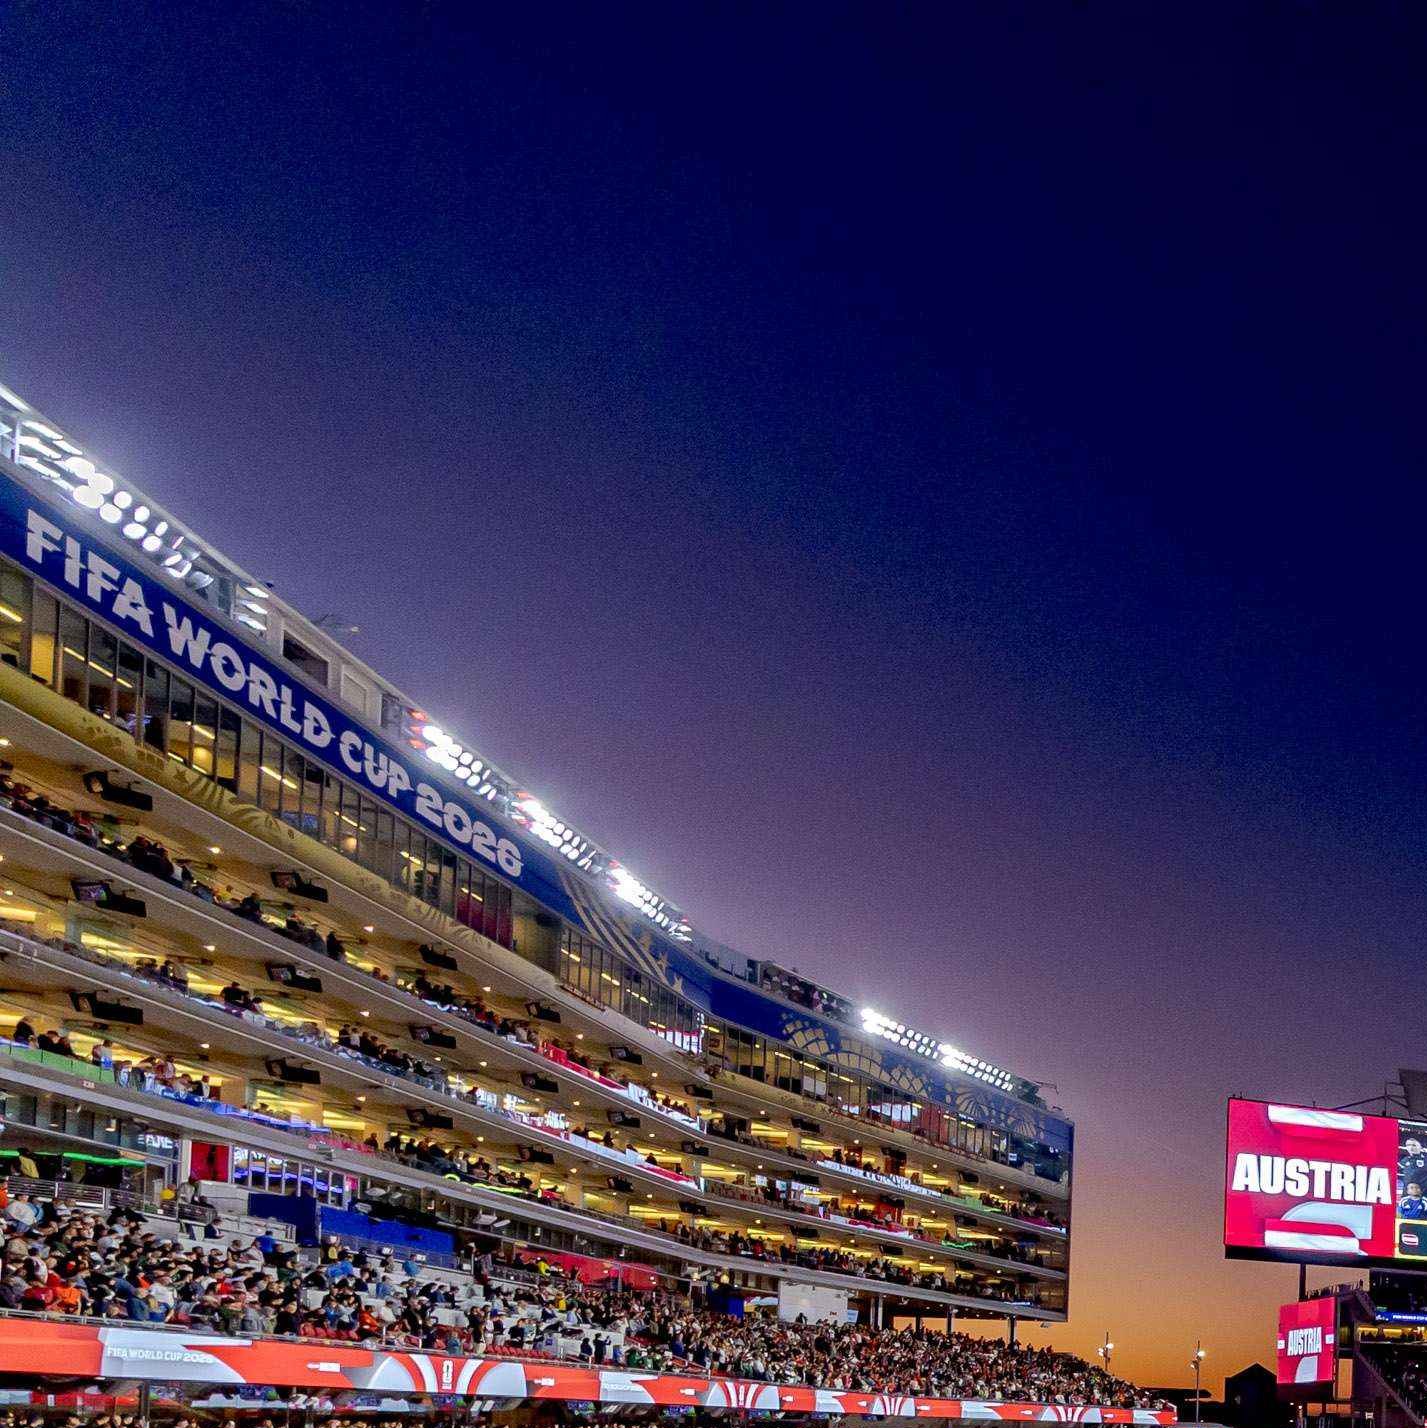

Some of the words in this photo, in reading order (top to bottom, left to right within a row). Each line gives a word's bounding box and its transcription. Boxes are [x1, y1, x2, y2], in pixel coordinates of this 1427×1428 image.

[26, 509, 154, 637] FIFA
[163, 602, 336, 748] WORLD
[340, 731, 414, 798] CUP
[416, 783, 524, 878] 2026
[1232, 1153, 1392, 1205] AUSTRIA
[107, 1345, 128, 1358] FIFA
[129, 1348, 162, 1360] WORLD
[164, 1351, 182, 1361] CUP
[1287, 1327, 1322, 1356] AUSTRIA
